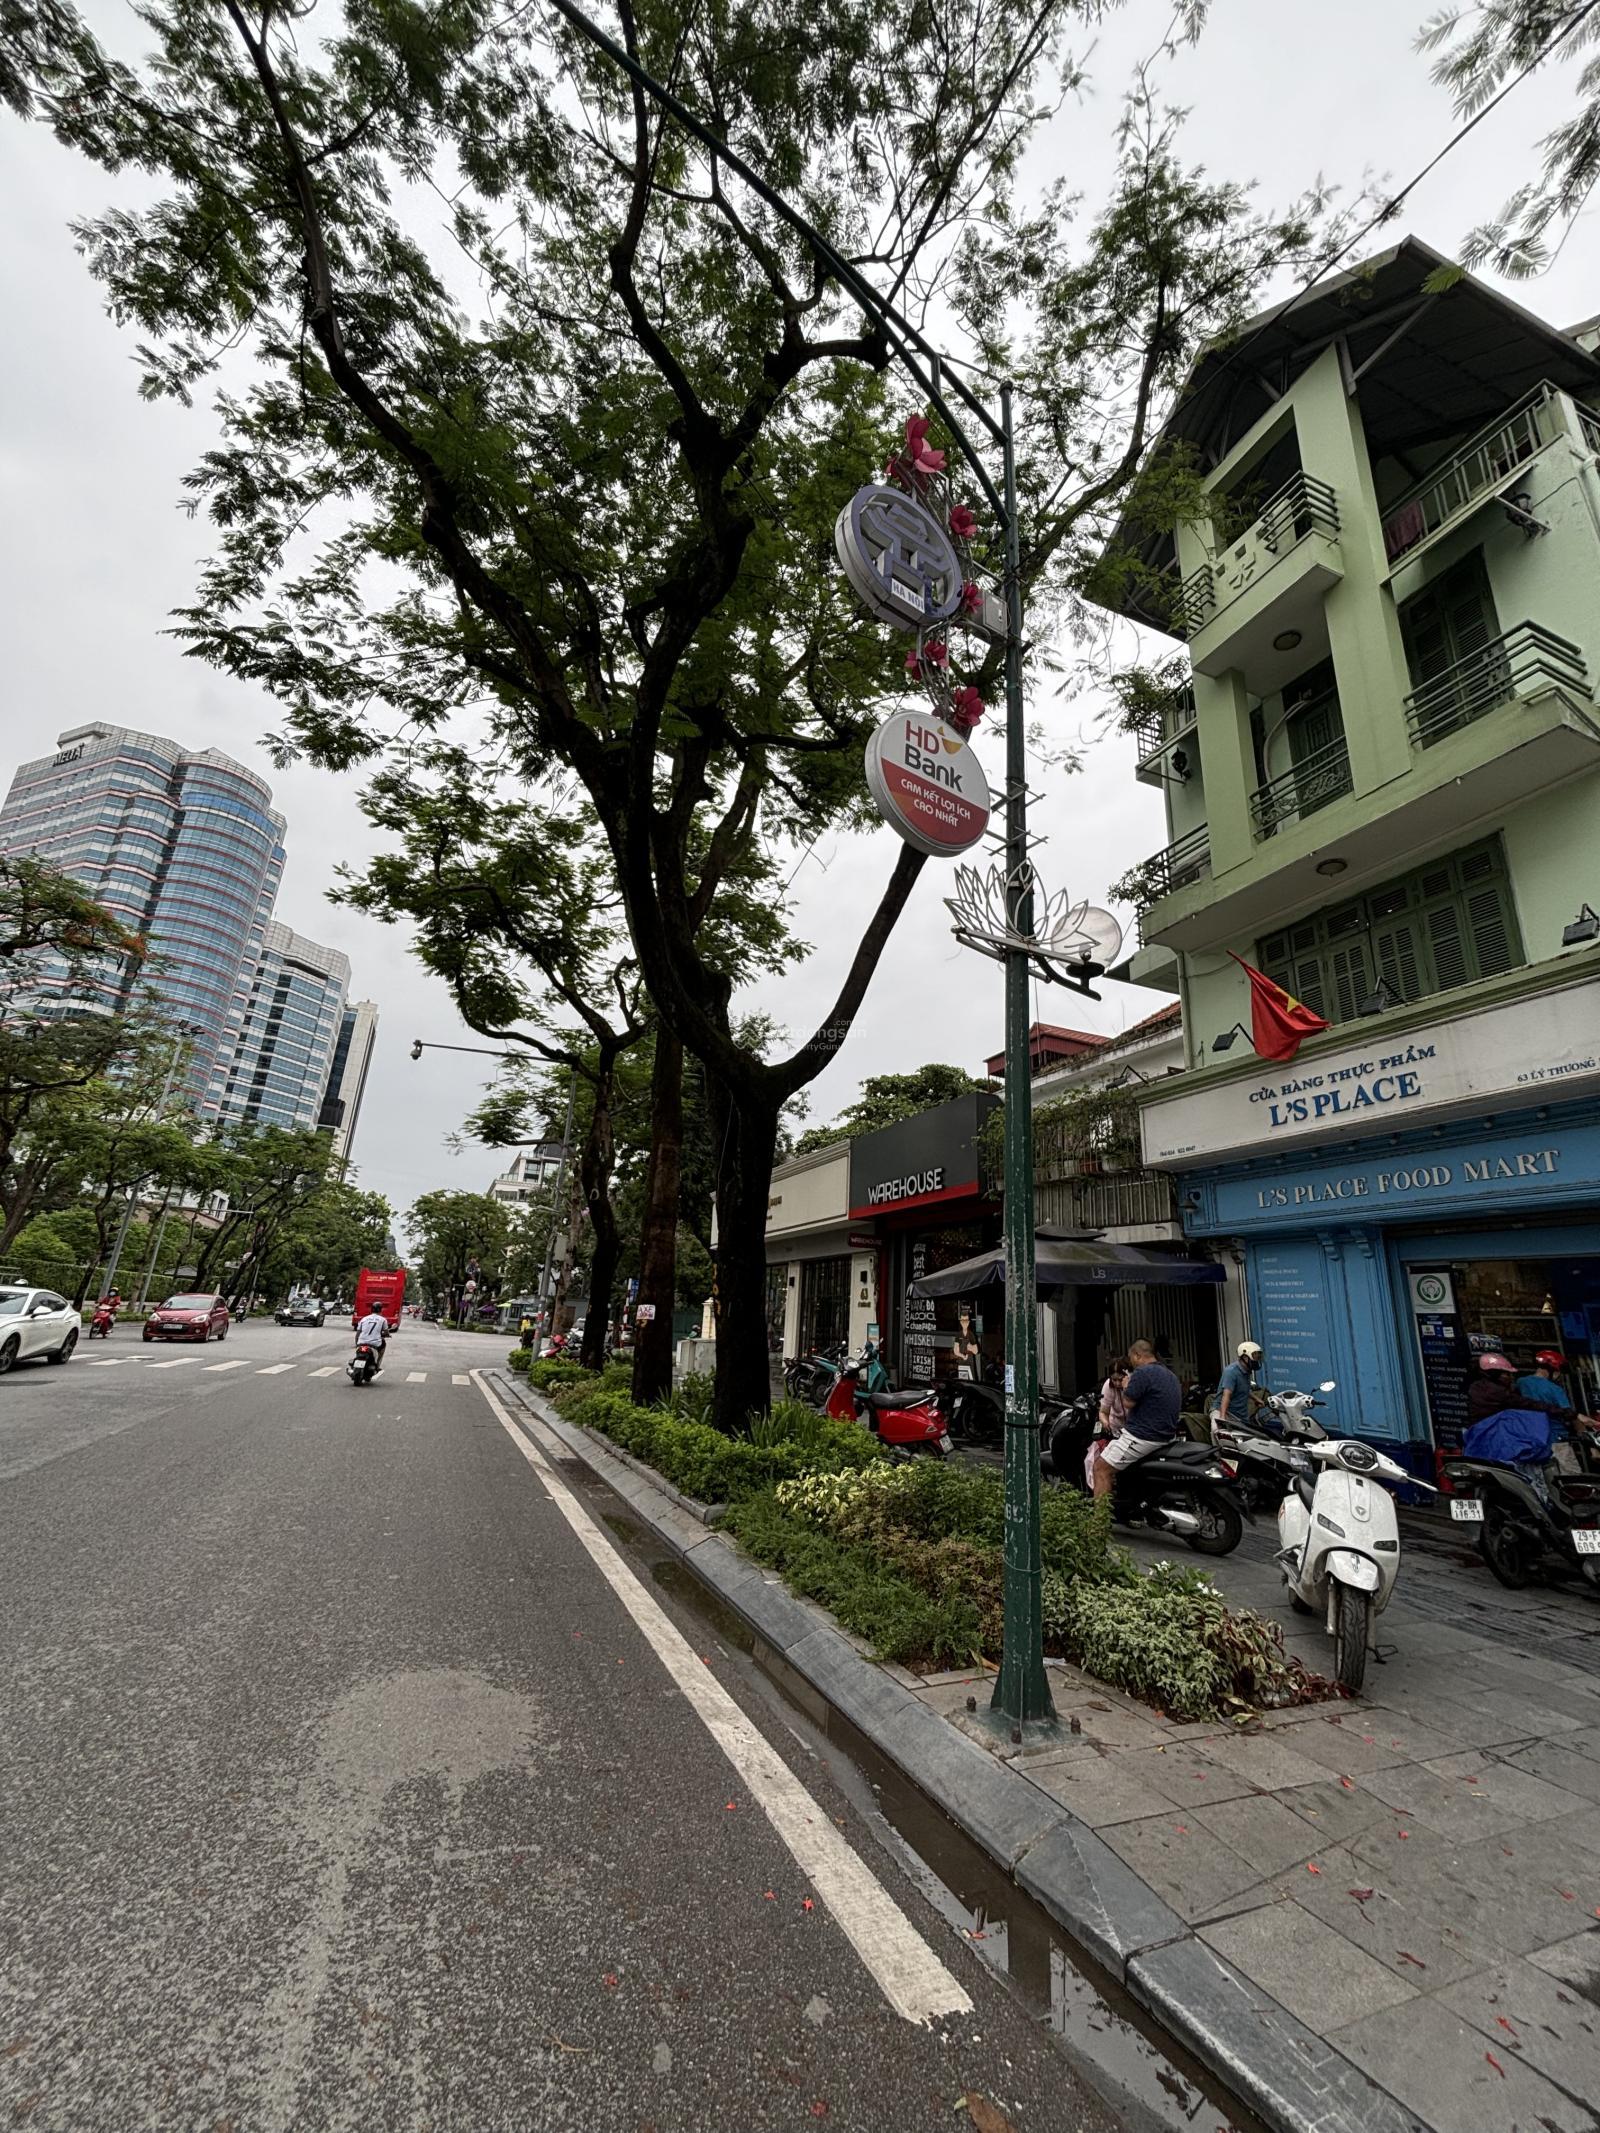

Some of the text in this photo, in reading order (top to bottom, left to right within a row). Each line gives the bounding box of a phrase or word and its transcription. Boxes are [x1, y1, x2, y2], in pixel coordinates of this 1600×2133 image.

[905, 720, 939, 755] HD
[904, 743, 962, 792] Bank
[901, 779, 922, 795] CAM
[923, 790, 939, 804] KẾT
[914, 799, 958, 826] CAO NHẤT
[1249, 1045, 1437, 1103] CỬA HÀNG THỰC PHẨM
[1517, 1073, 1529, 1082] 63
[1268, 1071, 1421, 1127] L'S PLACE
[868, 1167, 943, 1205] WAREHOUSE
[1258, 1150, 1561, 1209] L'S PLACE FOOD MART
[368, 1321, 377, 1336] 7
[904, 1333, 937, 1346] WHISKEY
[912, 1355, 931, 1365] IRISH
[912, 1364, 931, 1375] MERLOT
